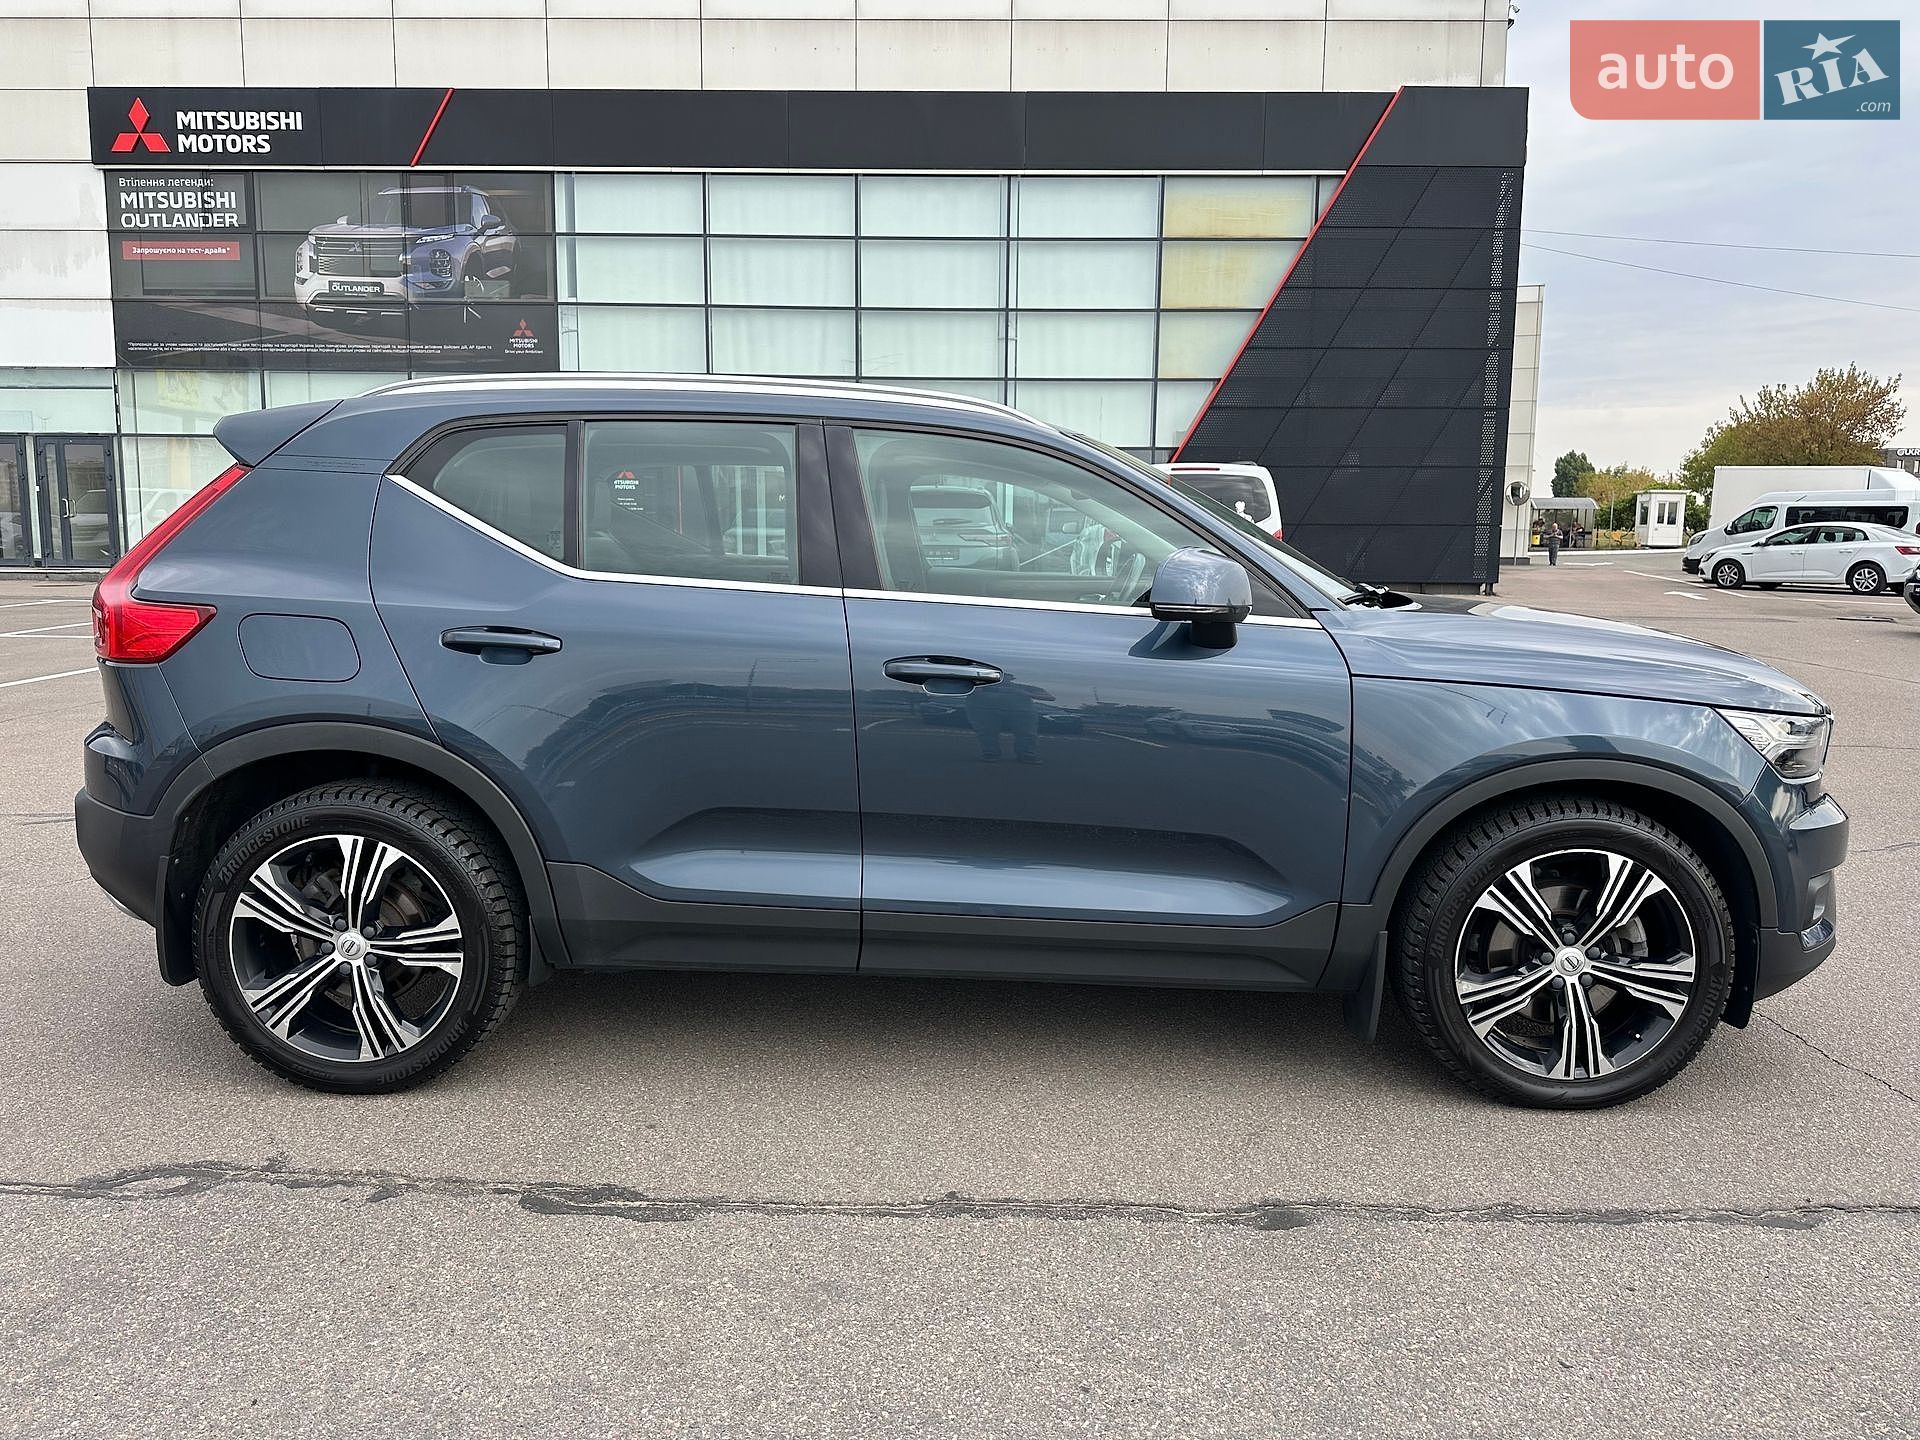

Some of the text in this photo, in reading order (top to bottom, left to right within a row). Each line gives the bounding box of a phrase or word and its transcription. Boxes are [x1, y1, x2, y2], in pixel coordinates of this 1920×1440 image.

[176, 111, 303, 131] MITSUBISHI
[177, 134, 271, 153] MOTORS
[119, 177, 214, 188] Втілення легенди:
[120, 191, 237, 209] MITSUBISHI
[121, 212, 239, 228] OUTLANDER
[132, 246, 176, 255] Запрошуємо
[331, 284, 381, 293] OUTLANDER
[218, 815, 312, 886] BRIDGESTONE
